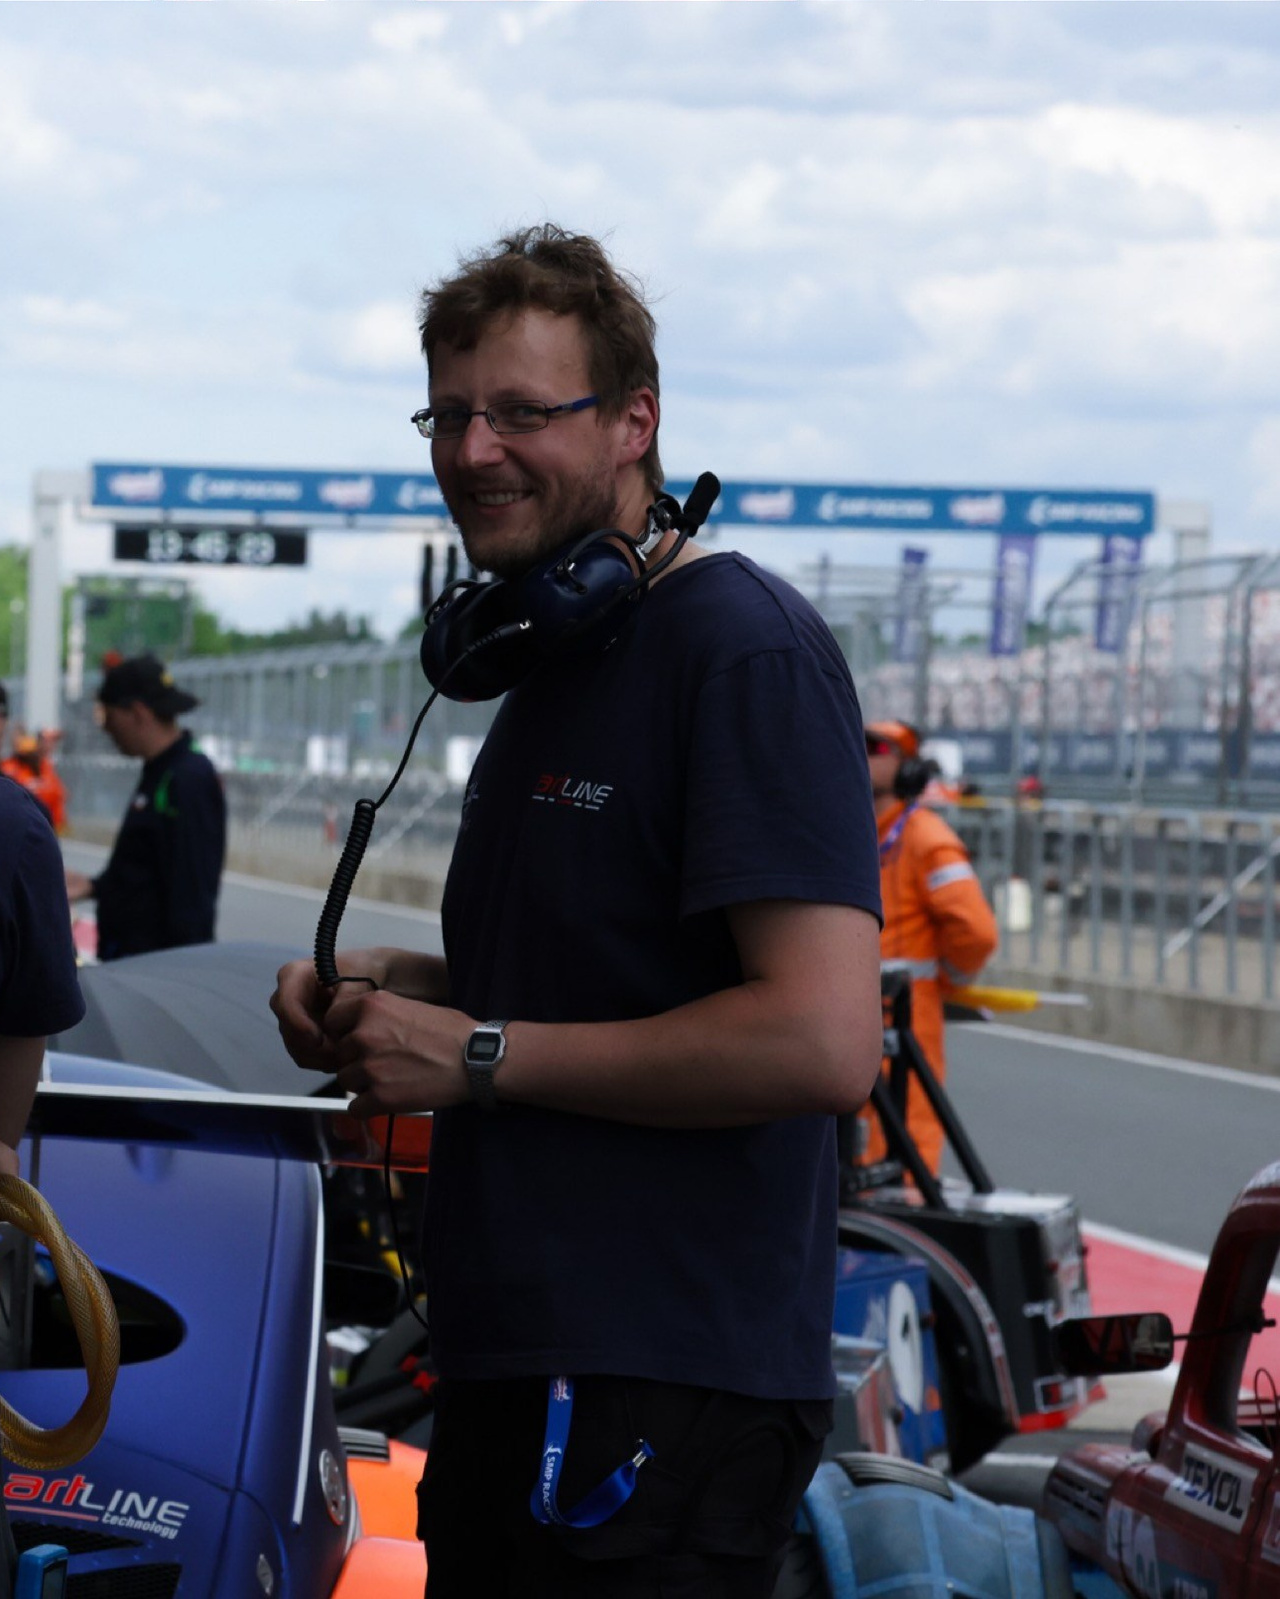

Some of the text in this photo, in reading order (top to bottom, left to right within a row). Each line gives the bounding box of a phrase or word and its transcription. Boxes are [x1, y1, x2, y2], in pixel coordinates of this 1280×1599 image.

[536, 772, 614, 804] artLINE
[3, 1473, 189, 1527] artLINE
[101, 1511, 179, 1540] technology
